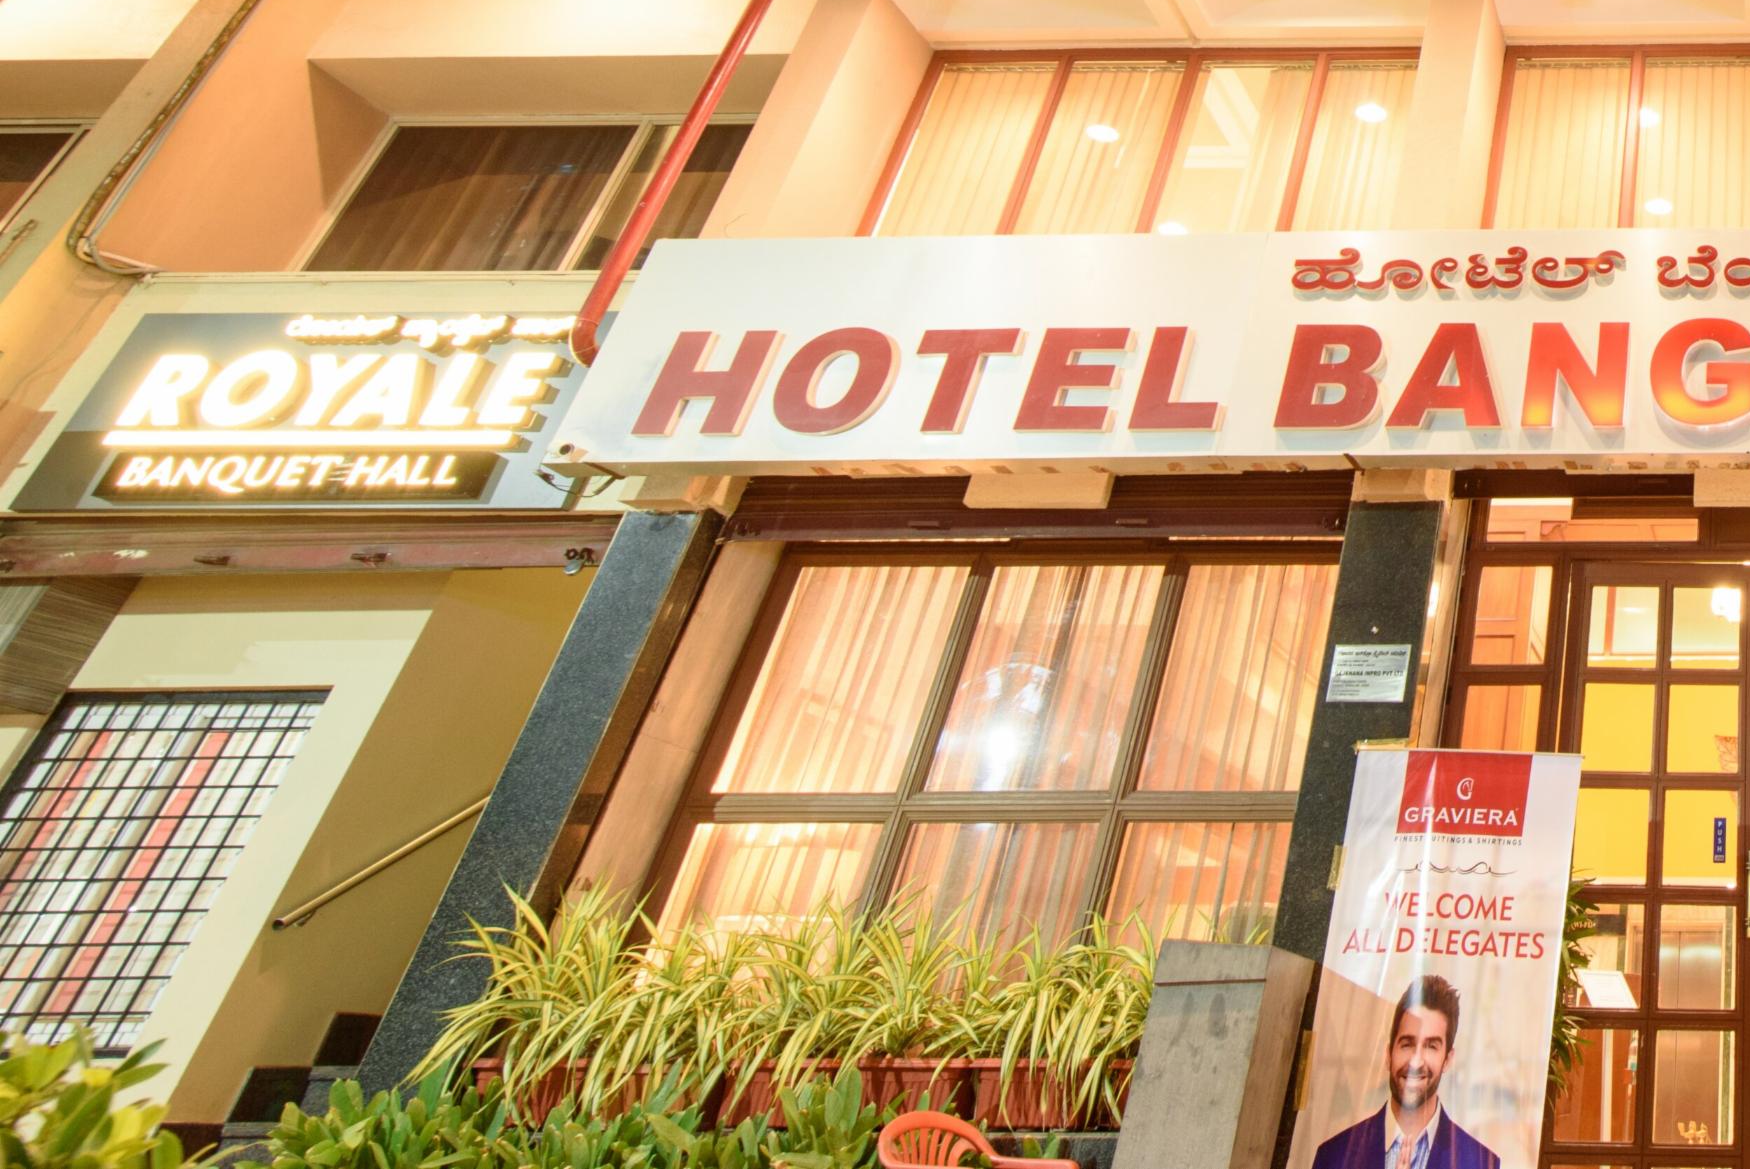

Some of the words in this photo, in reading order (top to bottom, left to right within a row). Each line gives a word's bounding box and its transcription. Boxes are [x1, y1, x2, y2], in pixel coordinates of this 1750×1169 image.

[1291, 245, 1626, 292] ಹೋಟೆಲ್
[115, 349, 557, 428] ROYALE
[632, 326, 1226, 436] HOTEL
[116, 455, 337, 494] BANQUET
[344, 455, 458, 487] HALL
[1404, 807, 1518, 826] GRAVIERA
[1427, 836, 1466, 845] UITINGS
[1477, 837, 1523, 846] SHIRTINGS
[1342, 927, 1388, 955] ALL
